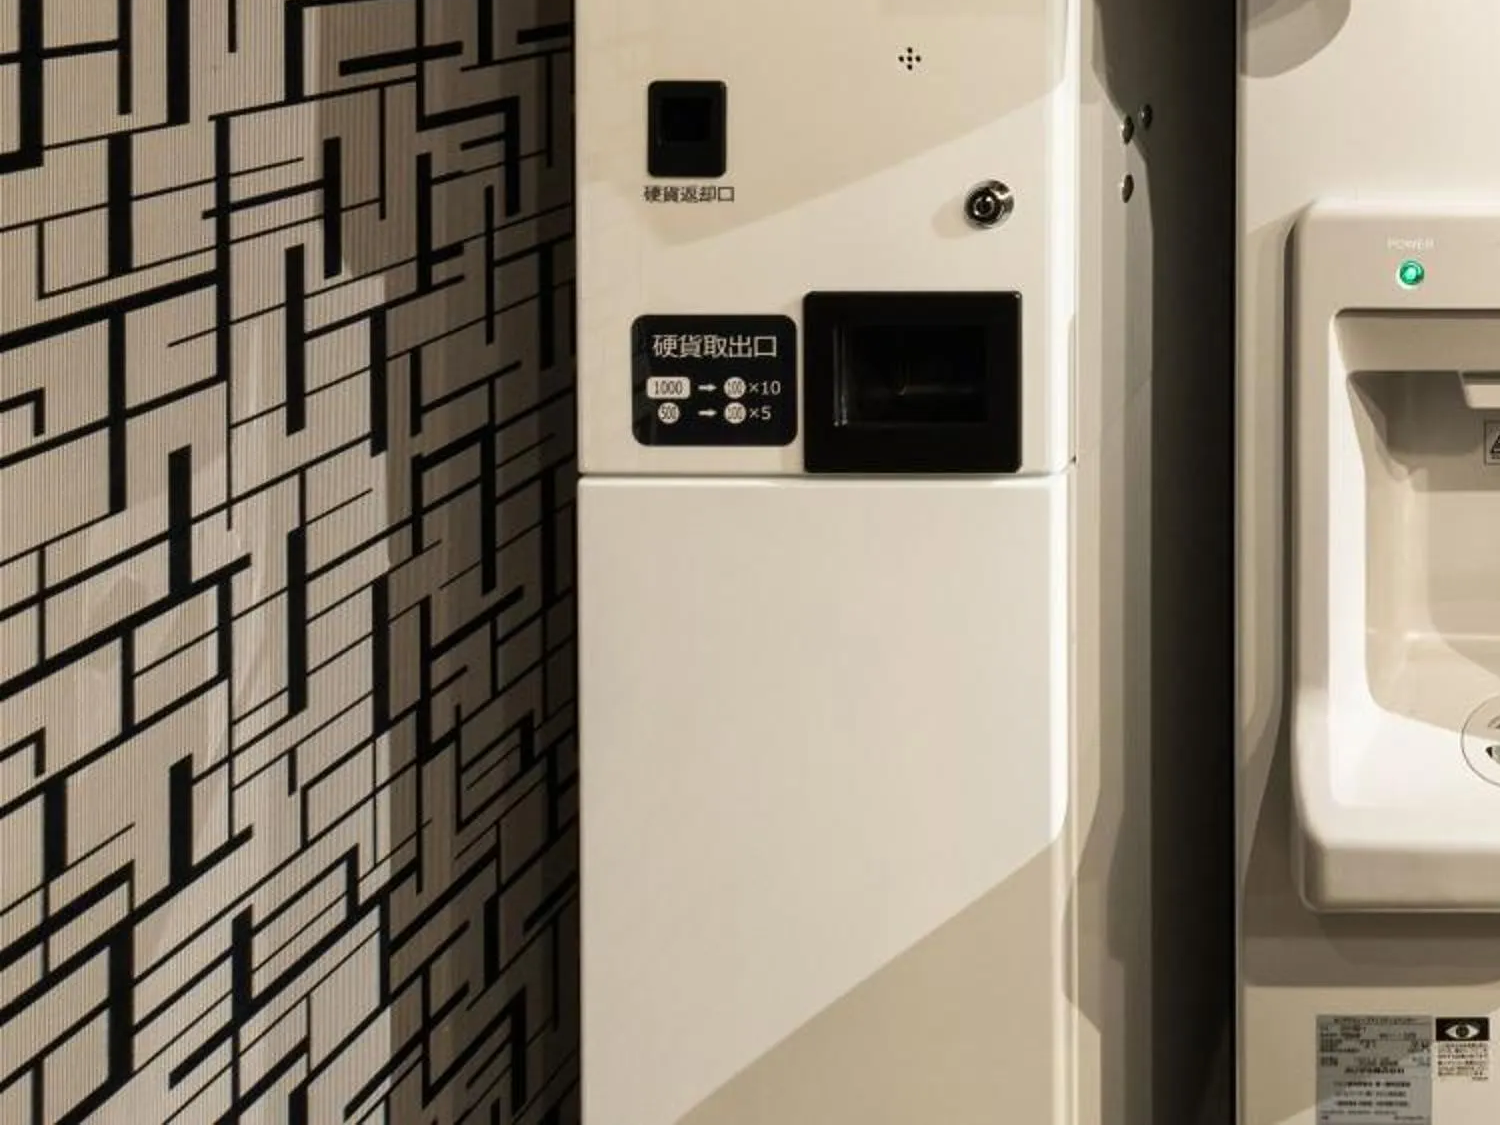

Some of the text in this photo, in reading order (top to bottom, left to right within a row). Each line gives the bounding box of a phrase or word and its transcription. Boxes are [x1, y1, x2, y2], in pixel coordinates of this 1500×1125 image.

[644, 185, 735, 204] 硬貨返却口
[652, 334, 778, 358] 硬貨取出口
[653, 380, 684, 395] 1000
